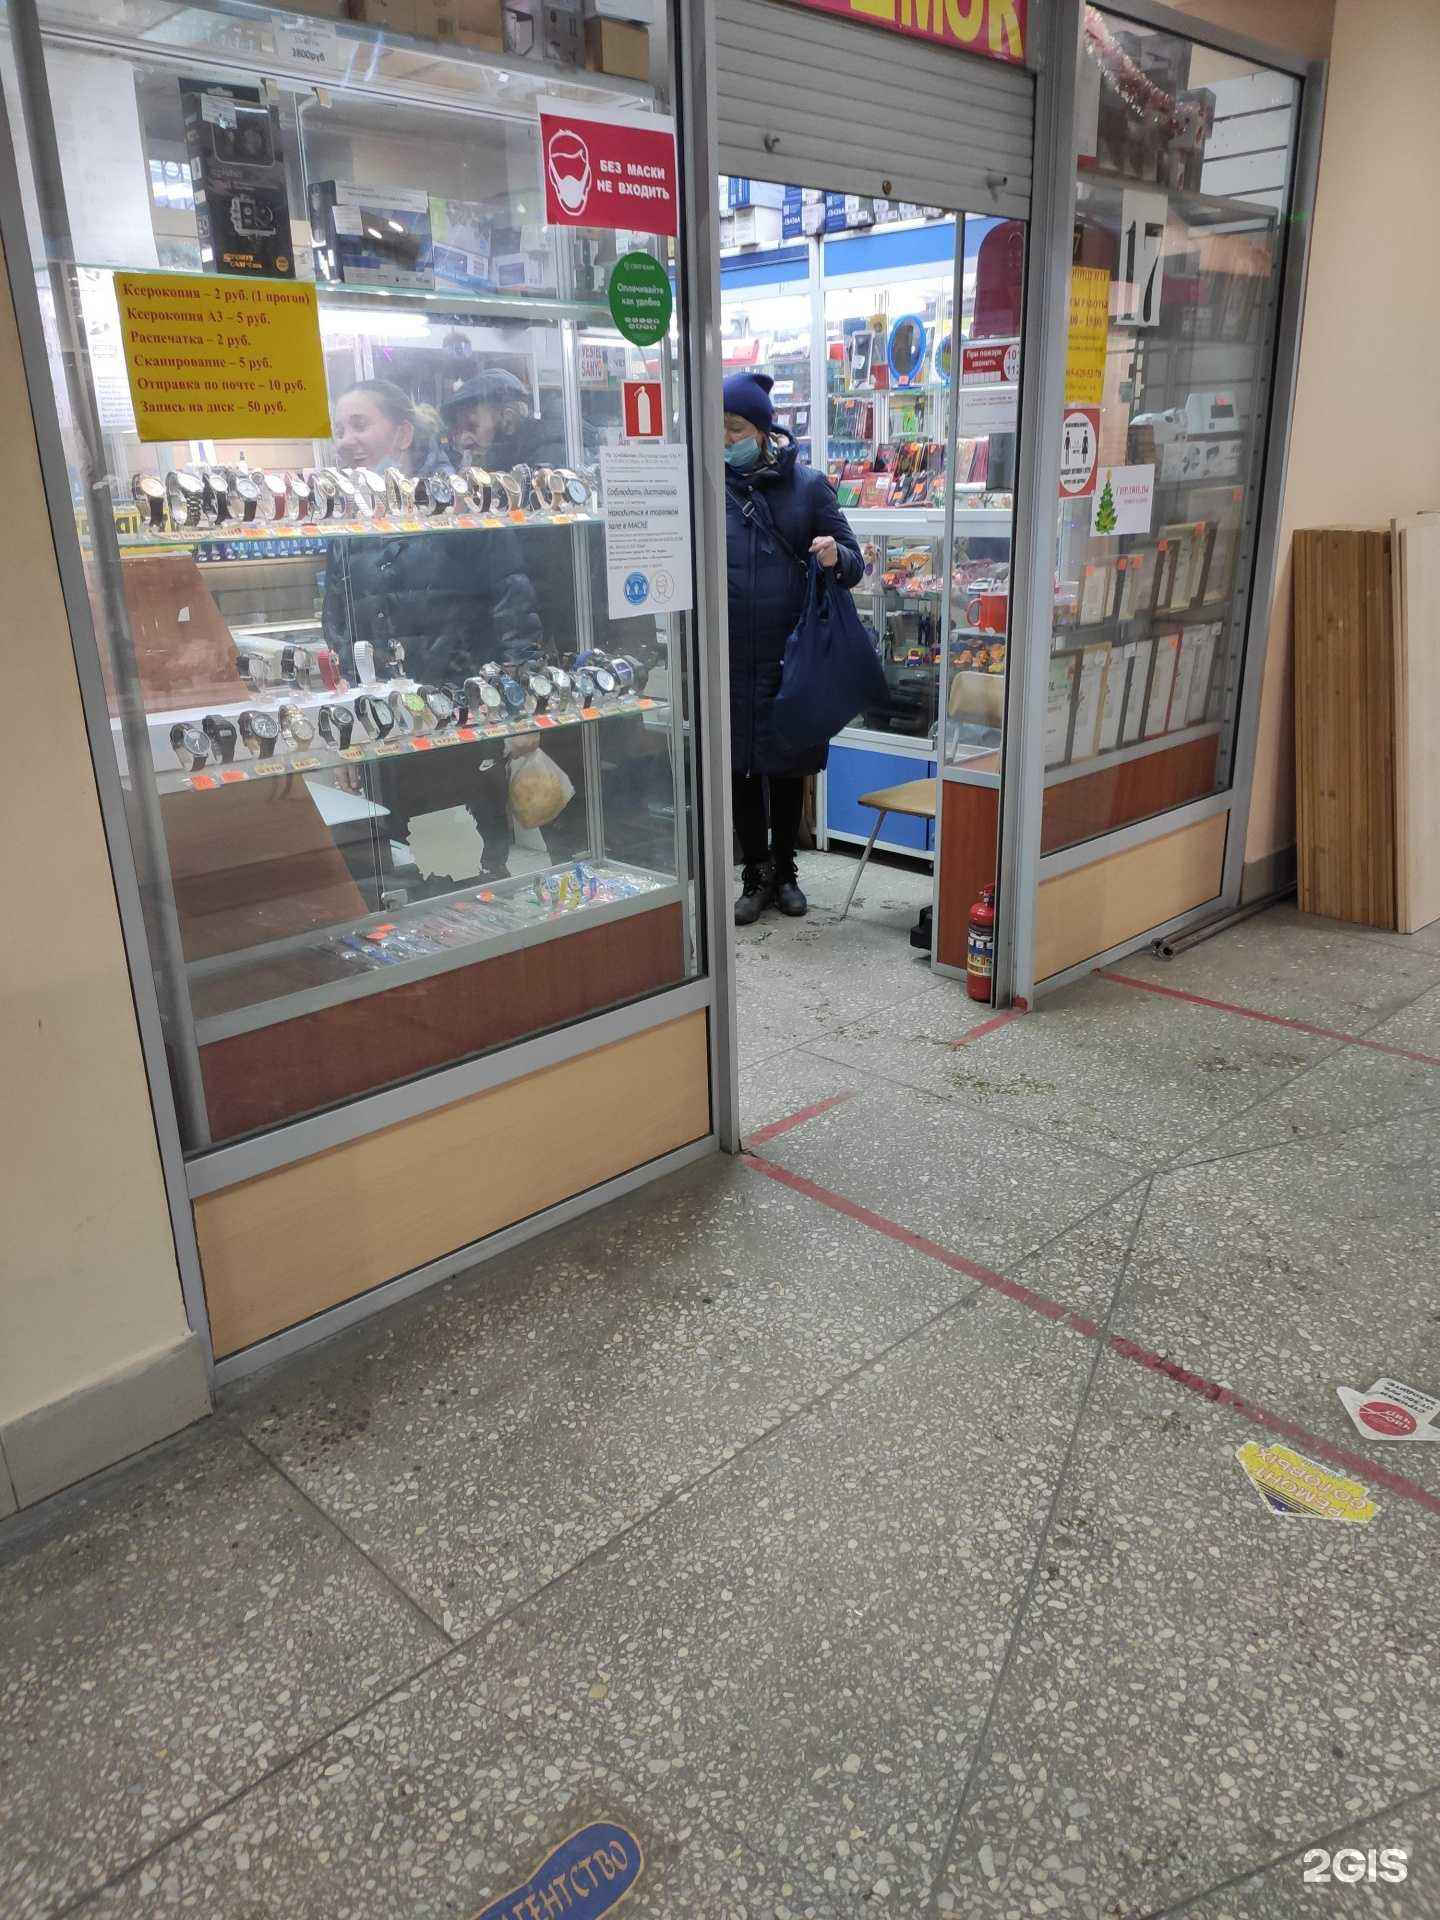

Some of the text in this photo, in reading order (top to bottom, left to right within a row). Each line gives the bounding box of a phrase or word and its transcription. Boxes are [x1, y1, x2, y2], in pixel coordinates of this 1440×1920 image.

[599, 159, 666, 180] БЕЗ МАСКИ
[596, 178, 671, 200] НЕ ВХОДИТЬ
[122, 282, 201, 299] Ксерокопия
[214, 288, 221, 300] 2
[224, 289, 249, 303] руб.
[252, 290, 262, 304] (1
[265, 293, 311, 305] прогон)
[616, 283, 664, 294] Оплачивайте
[621, 297, 661, 308] как удобно
[127, 307, 204, 323] Ксерокопия
[208, 311, 224, 322] А3
[237, 312, 244, 323] 5
[247, 313, 271, 326] руб.
[131, 331, 204, 345] Распечатка
[217, 334, 223, 345] 2
[227, 335, 252, 348] руб.
[967, 348, 1002, 359] При пожаре
[134, 354, 226, 370] Сканирование
[239, 358, 246, 368] 5
[249, 358, 273, 371] руб.
[972, 360, 997, 368] звонить
[137, 378, 201, 392] Отправка
[204, 381, 218, 390] по
[222, 381, 256, 391] почте
[269, 379, 281, 391] 10
[284, 380, 306, 393] руб.
[142, 401, 185, 413] Запись
[189, 403, 203, 413] на
[207, 403, 235, 413] диск
[248, 401, 260, 412] 50
[264, 401, 286, 414] руб.
[1256, 1447, 1367, 1511] СОТОВЫХ
[1256, 1468, 1344, 1517] РЕМОНТ
